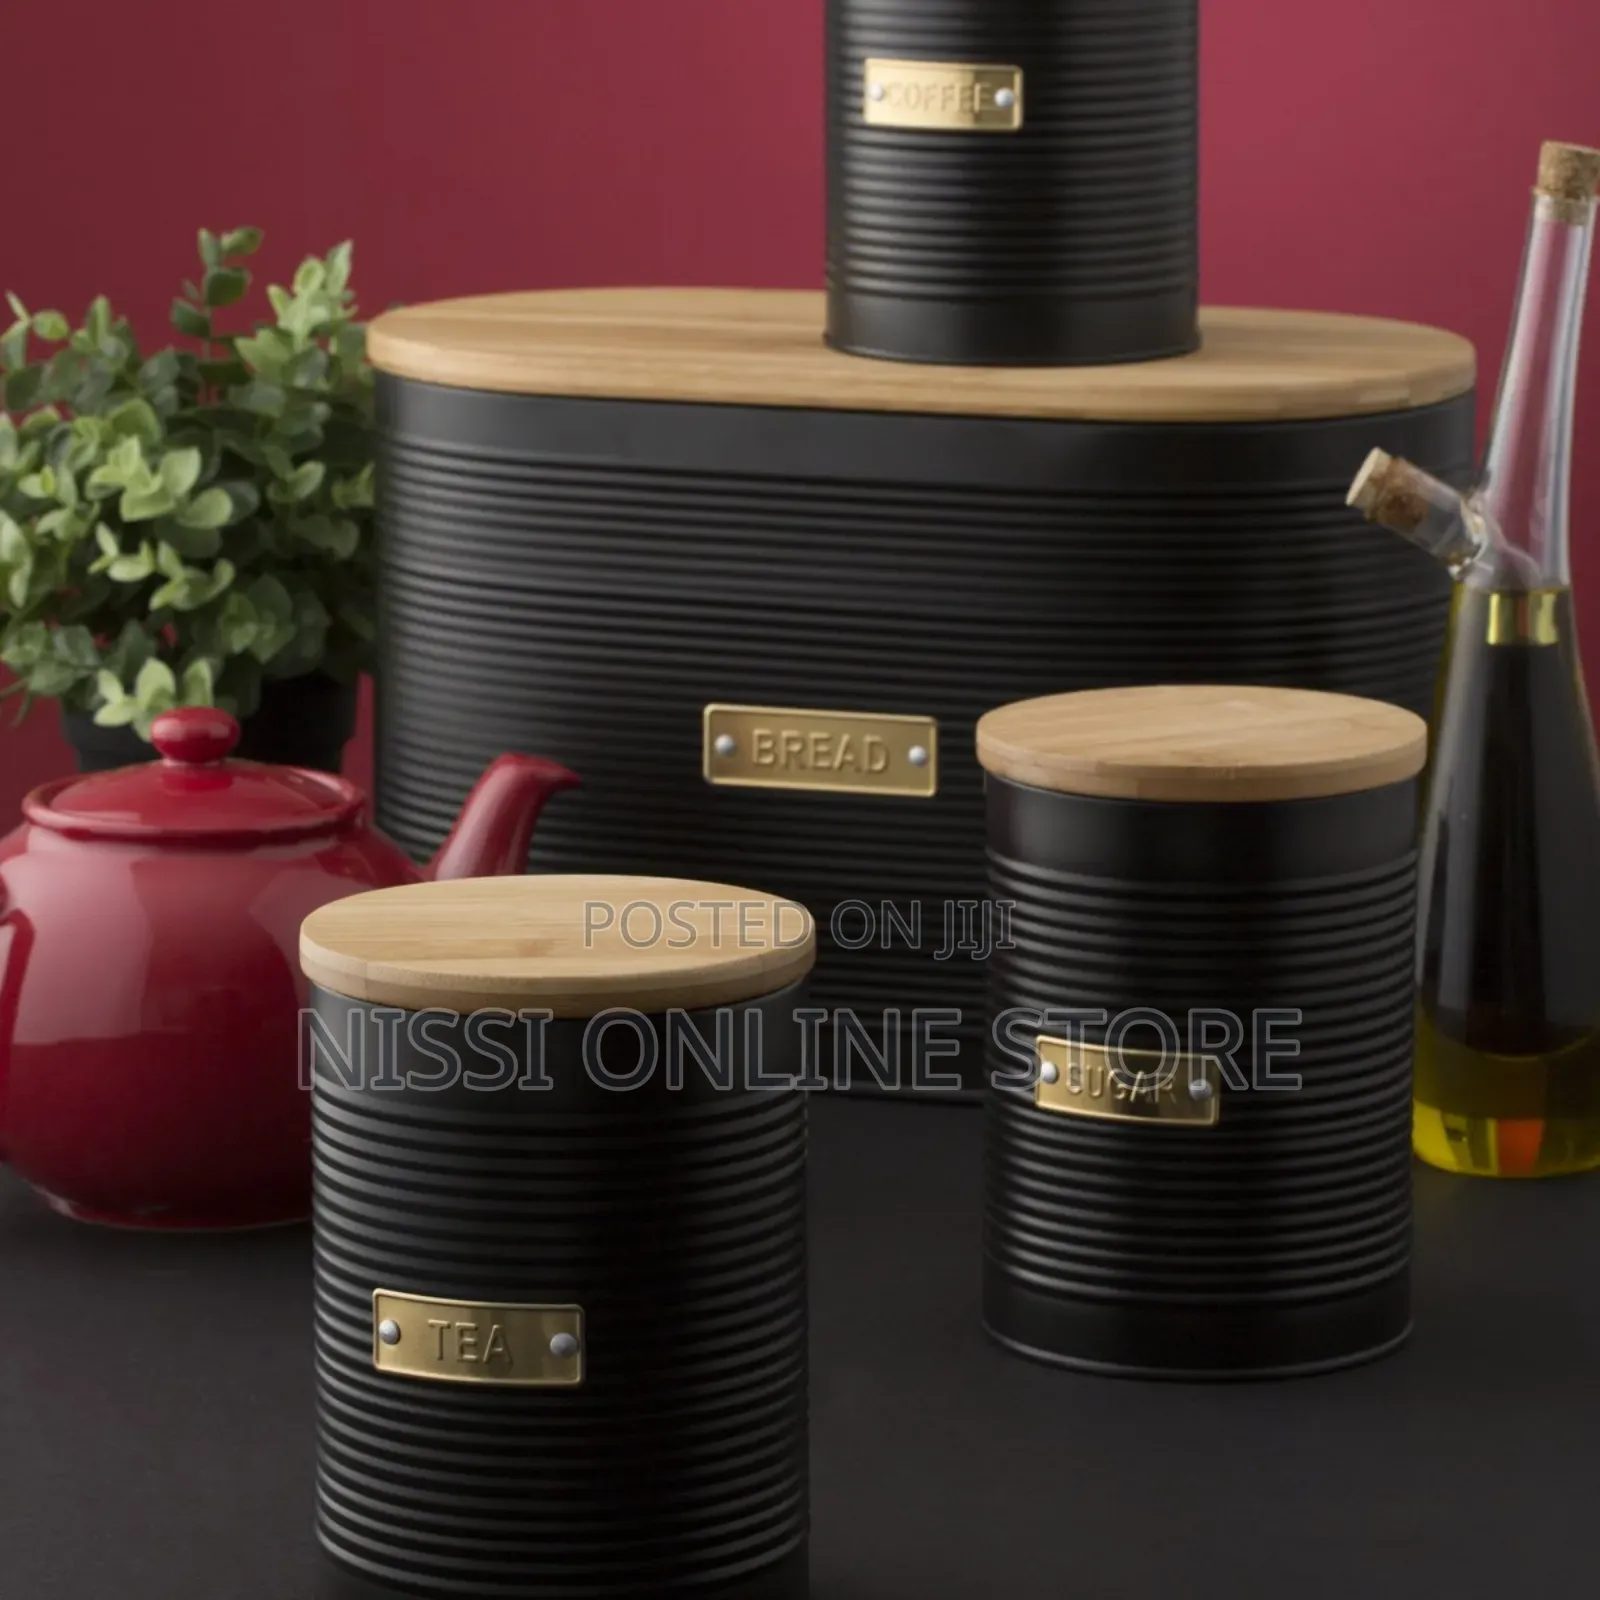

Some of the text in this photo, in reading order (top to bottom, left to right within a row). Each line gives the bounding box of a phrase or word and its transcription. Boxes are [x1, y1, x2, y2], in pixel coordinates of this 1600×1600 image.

[886, 81, 996, 113] COFFEE
[752, 727, 890, 774] BREAD
[1066, 1061, 1178, 1105] SUGAR
[427, 1318, 515, 1366] TEA
